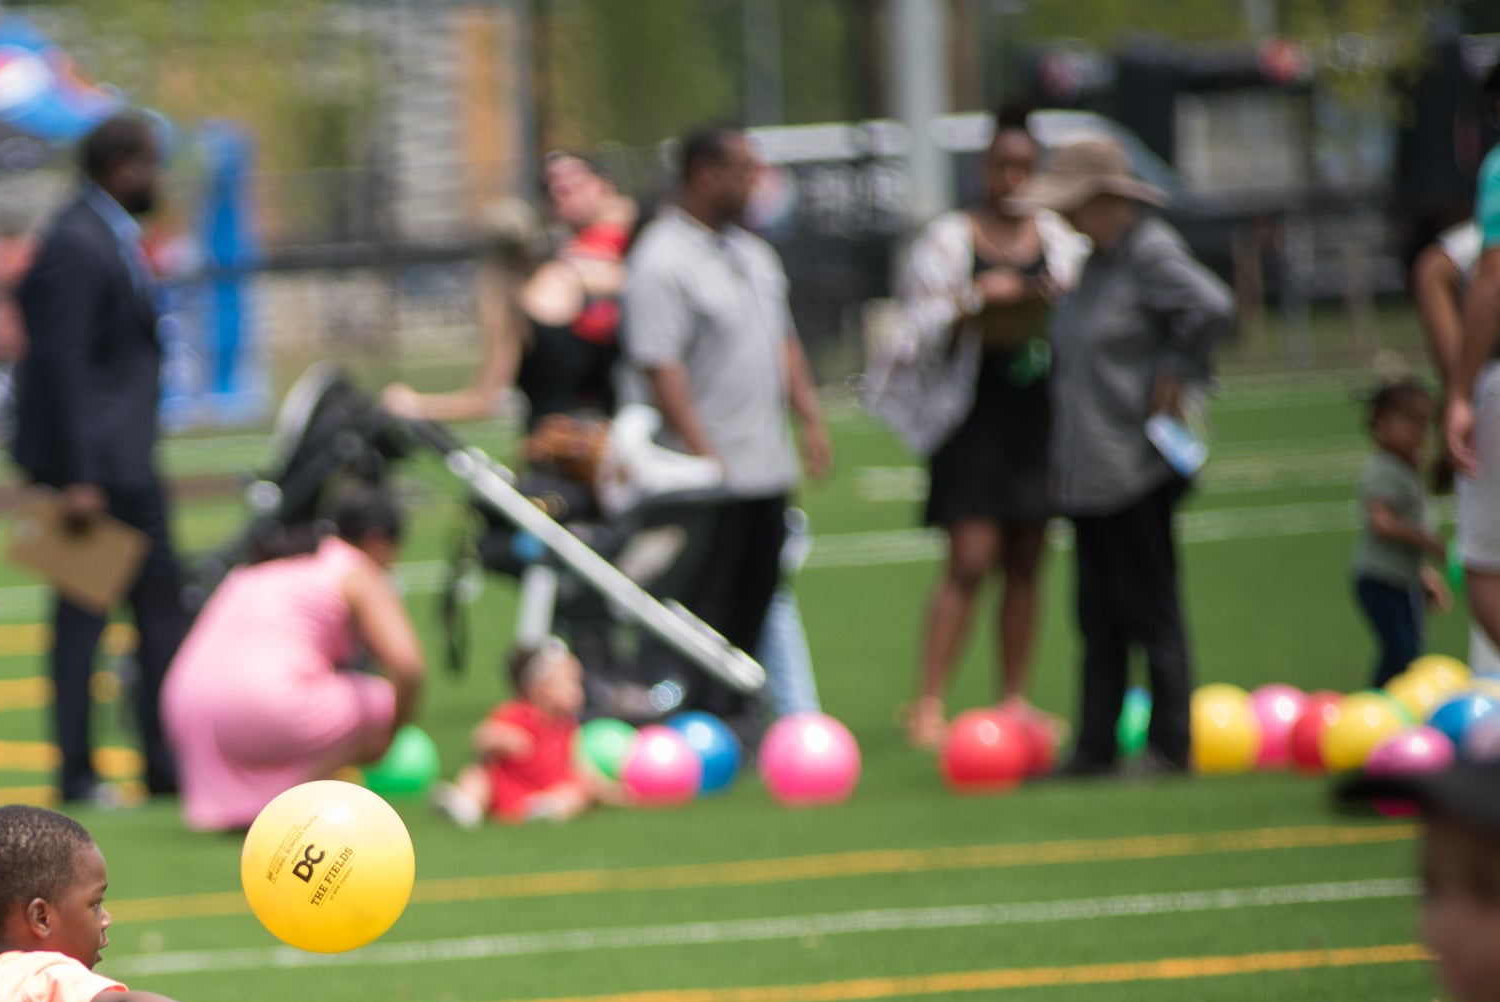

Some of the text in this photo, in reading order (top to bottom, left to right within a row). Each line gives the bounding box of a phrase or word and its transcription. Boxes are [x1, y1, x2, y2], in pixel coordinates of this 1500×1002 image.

[292, 844, 325, 883] DC
[310, 846, 353, 906] THE FIELDS
